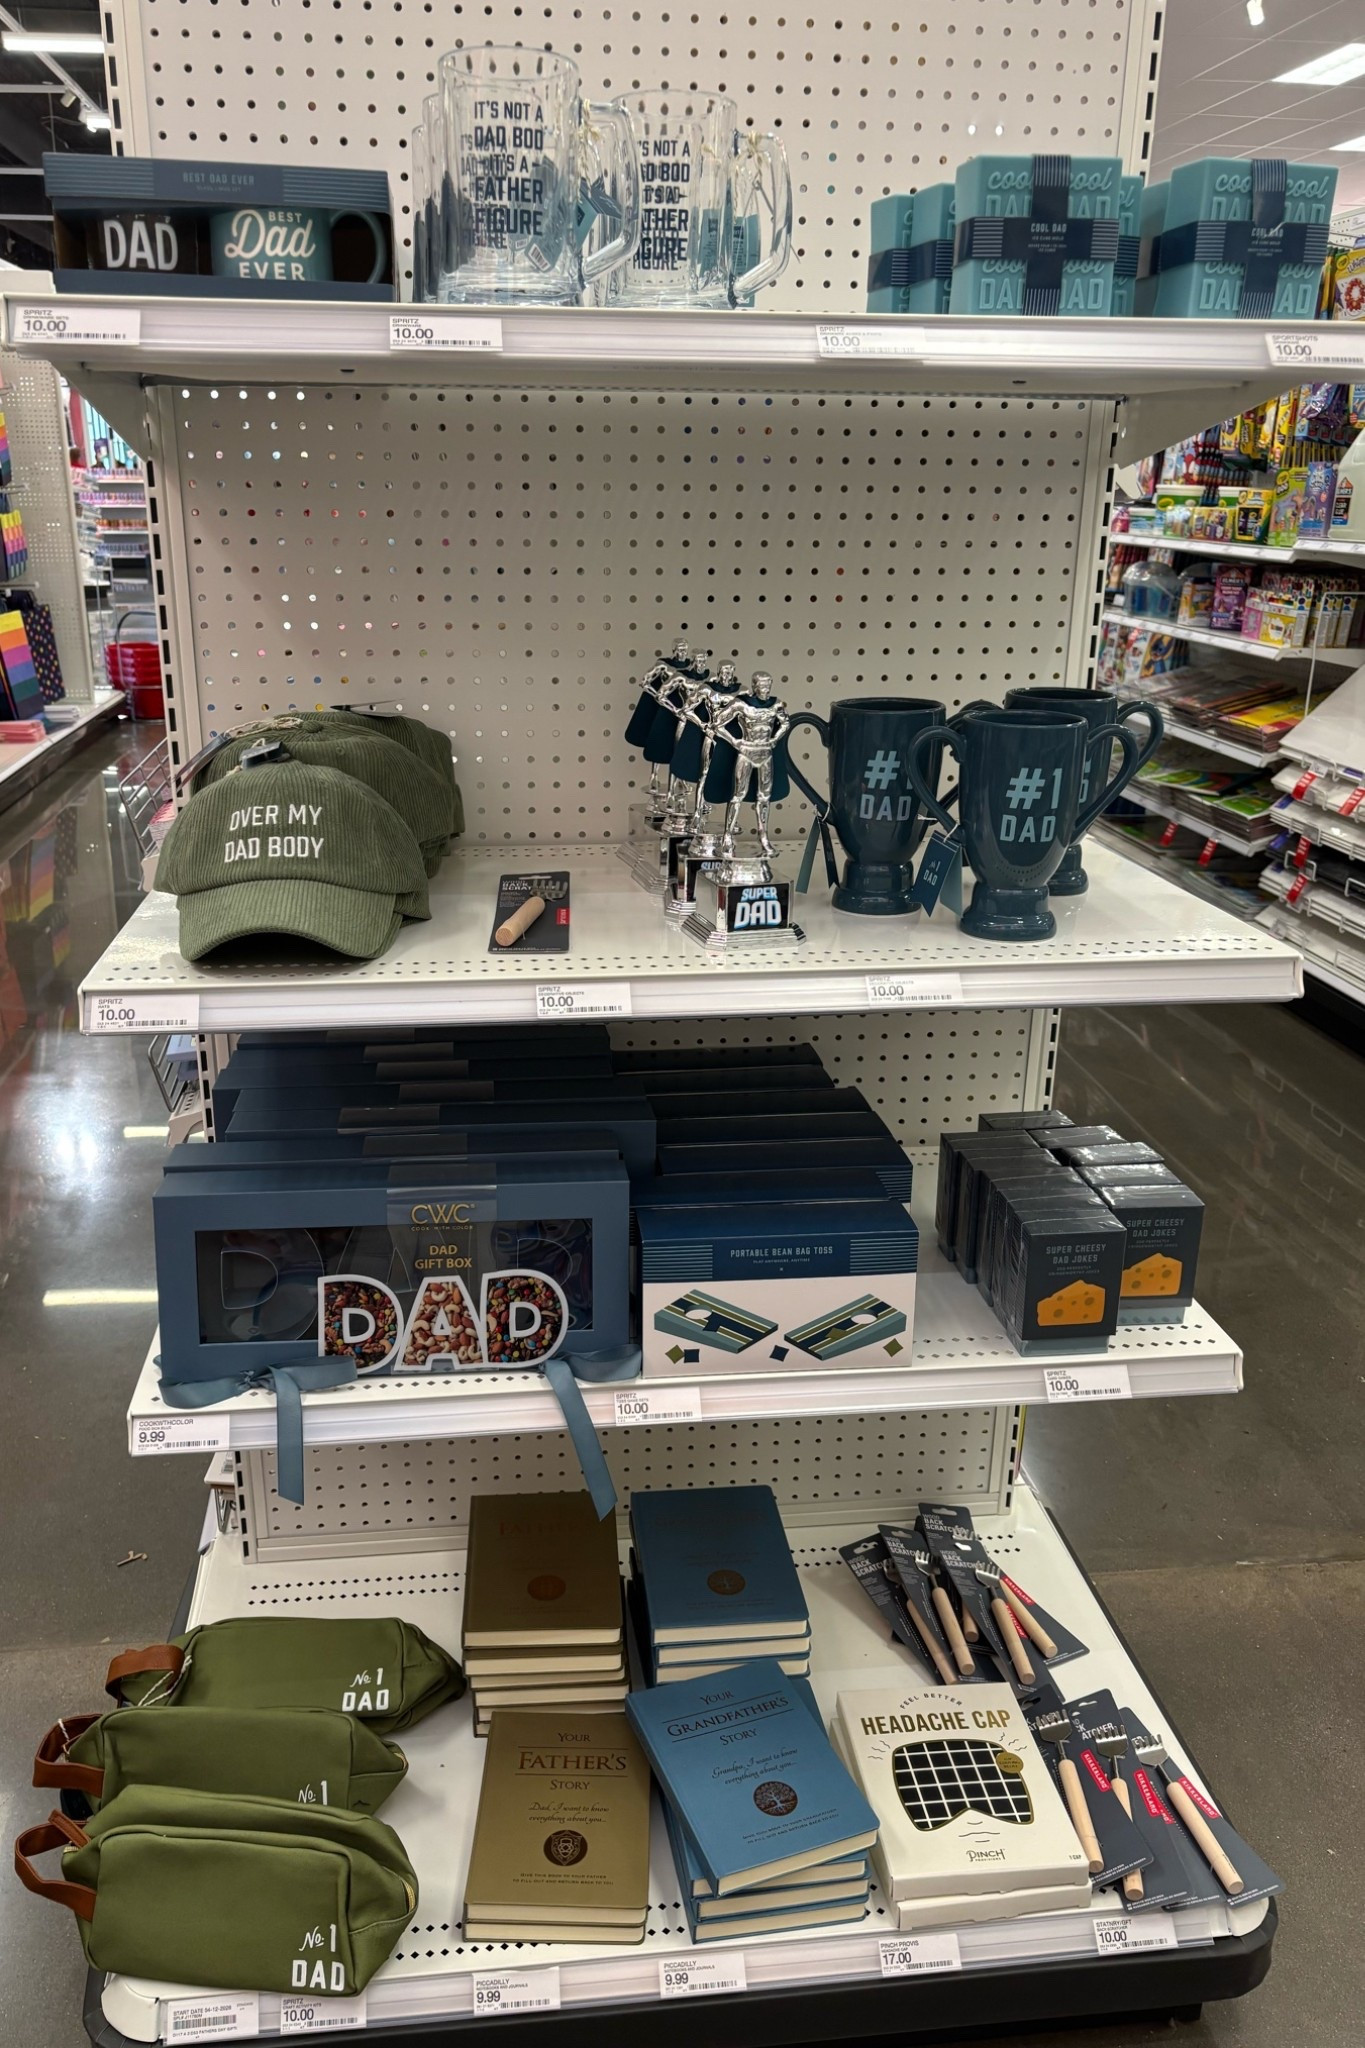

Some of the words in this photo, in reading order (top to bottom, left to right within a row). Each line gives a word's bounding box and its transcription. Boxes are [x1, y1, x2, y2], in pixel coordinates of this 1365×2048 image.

[474, 101, 499, 119] IT'S
[504, 101, 531, 120] NOT
[535, 105, 544, 122] A
[474, 125, 506, 149] DAD
[513, 127, 544, 151] BOD
[653, 140, 678, 157] NOT
[682, 141, 691, 157] A
[519, 155, 529, 173] A
[183, 172, 205, 183] BEST
[209, 173, 228, 184] DAD
[231, 174, 255, 185] EVER
[660, 163, 690, 183] BOD
[988, 171, 1032, 190] coo
[1070, 167, 1112, 190] ool
[475, 177, 544, 205] FATHER
[1215, 174, 1251, 193] coo
[986, 195, 1032, 217] DA
[1068, 195, 1111, 218] AD
[1211, 197, 1250, 220] DA
[268, 211, 302, 223] BEST
[475, 208, 544, 236] FIGURE
[642, 208, 689, 231] THER
[224, 209, 316, 259] Dad
[1031, 224, 1049, 232] COOL
[1052, 224, 1067, 232] DAD
[104, 220, 178, 271] DAD
[239, 261, 306, 281] EVER
[1272, 282, 1312, 314] AD
[24, 319, 67, 332] 10.00
[393, 328, 433, 339] 10.00
[822, 336, 860, 347] 10.00
[1275, 345, 1312, 356] 10.00
[1006, 767, 1063, 810] #1
[860, 795, 911, 821] DAD
[229, 804, 279, 831] OVER
[288, 803, 322, 826] MY
[1000, 815, 1056, 843] DAD
[224, 837, 260, 863] DAD
[268, 836, 324, 858] BODY
[924, 869, 938, 886] DAD
[741, 886, 777, 901] SUPER
[734, 901, 782, 929] DAD
[872, 985, 904, 996] 10.00
[540, 996, 574, 1007] 10.00
[99, 1009, 135, 1020] 10.00
[411, 1204, 470, 1224] CWC
[1126, 1220, 1151, 1228] SUPER
[1154, 1218, 1184, 1227] CHEESY
[1151, 1229, 1176, 1237] JOKES
[429, 1245, 458, 1256] DAD
[731, 1249, 769, 1258] PORTABLE
[772, 1248, 793, 1256] BEAN
[795, 1247, 811, 1255] BAG
[814, 1246, 833, 1255] TOSS
[1046, 1246, 1072, 1254] SUPER
[1075, 1244, 1106, 1253] CHEESY
[415, 1259, 443, 1269] GIFT
[446, 1258, 472, 1268] BOX
[1053, 1256, 1069, 1264] DAD
[1072, 1254, 1098, 1263] JOKES
[318, 1269, 569, 1375] DAD
[1049, 1380, 1079, 1391] 10.00
[618, 1403, 648, 1414] 10.00
[139, 1431, 165, 1443] 9.99
[887, 1541, 905, 1549] BACK
[850, 1559, 872, 1570] BACK
[376, 1667, 384, 1685] 1
[342, 1688, 389, 1711] DAD
[700, 1691, 734, 1705] YOUR
[900, 1695, 919, 1709] FEEL
[924, 1693, 963, 1706] BETTER
[667, 1697, 789, 1737] GRANDFATHER'S
[861, 1711, 969, 1735] HEADACHE
[971, 1709, 1011, 1729] CAP
[558, 1732, 591, 1742] YOUR
[719, 1728, 758, 1746] STORY
[518, 1752, 626, 1770] FATHER'S
[756, 1754, 773, 1764] want
[781, 1747, 798, 1758] know
[725, 1768, 760, 1784] everything
[760, 1763, 779, 1775] about
[550, 1779, 590, 1790] STORY
[320, 1780, 328, 1806] 1
[590, 1802, 609, 1812] know
[528, 1812, 565, 1824] everything
[566, 1812, 587, 1822] about
[966, 1849, 1005, 1862] PINCH
[330, 1923, 337, 1952] 1
[1098, 1931, 1128, 1943] 10.00
[664, 1961, 697, 1969] PICCADILLY
[882, 1952, 912, 1965] 17.00
[291, 1959, 345, 1991] DAD
[665, 1972, 689, 1985] 9.99
[477, 1991, 501, 2003] 9.99
[284, 2009, 314, 2022] 10.00
